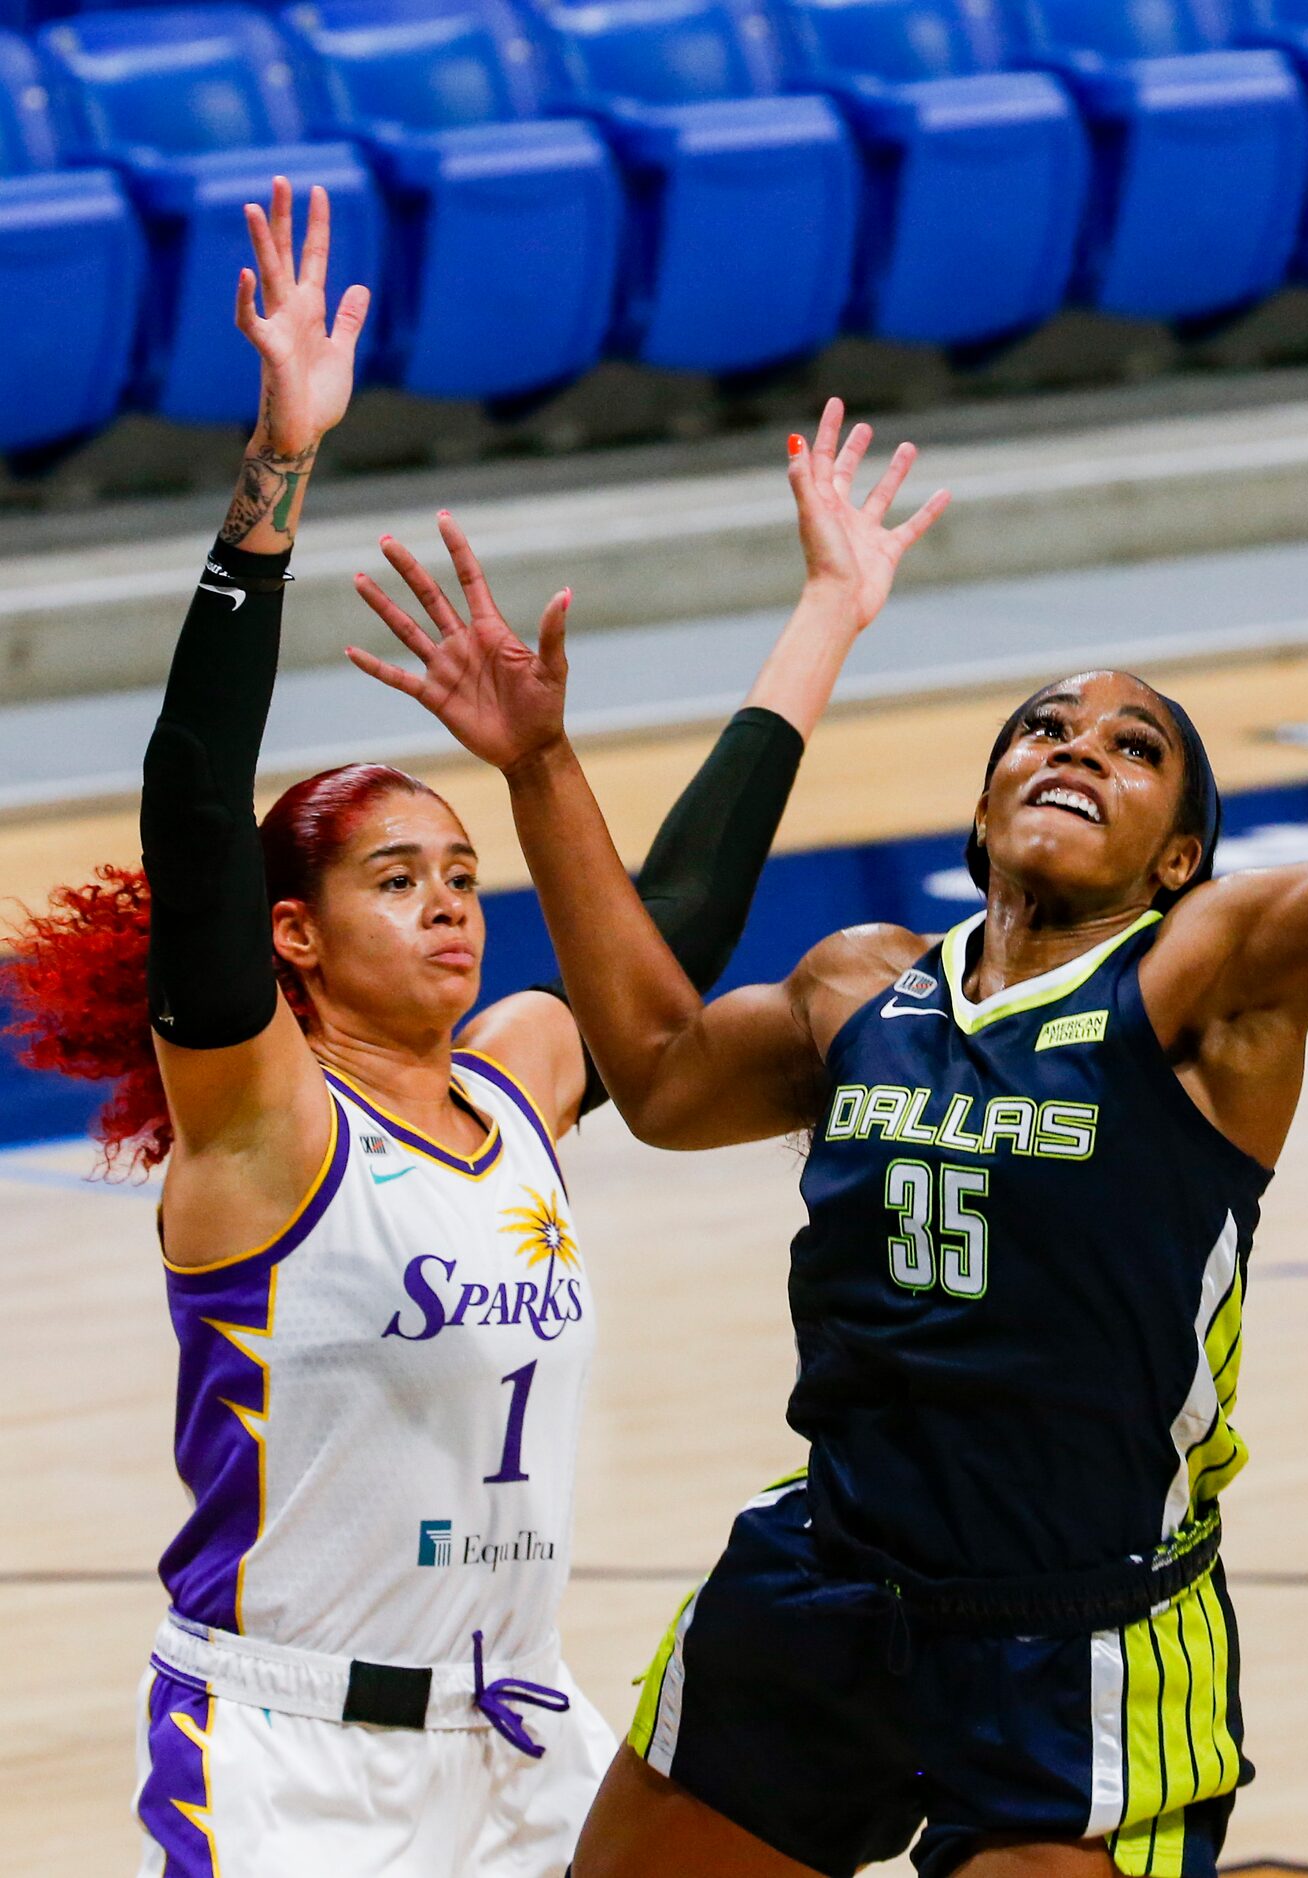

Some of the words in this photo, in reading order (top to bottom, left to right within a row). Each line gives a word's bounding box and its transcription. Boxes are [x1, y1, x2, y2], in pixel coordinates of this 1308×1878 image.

[1043, 1016, 1103, 1036] AMERICAN
[1048, 1027, 1100, 1044] FIDELITY
[825, 1084, 1099, 1160] DALLAS
[886, 1159, 988, 1299] 35
[381, 1254, 582, 1340] SPARKS
[482, 1360, 537, 1484] 1
